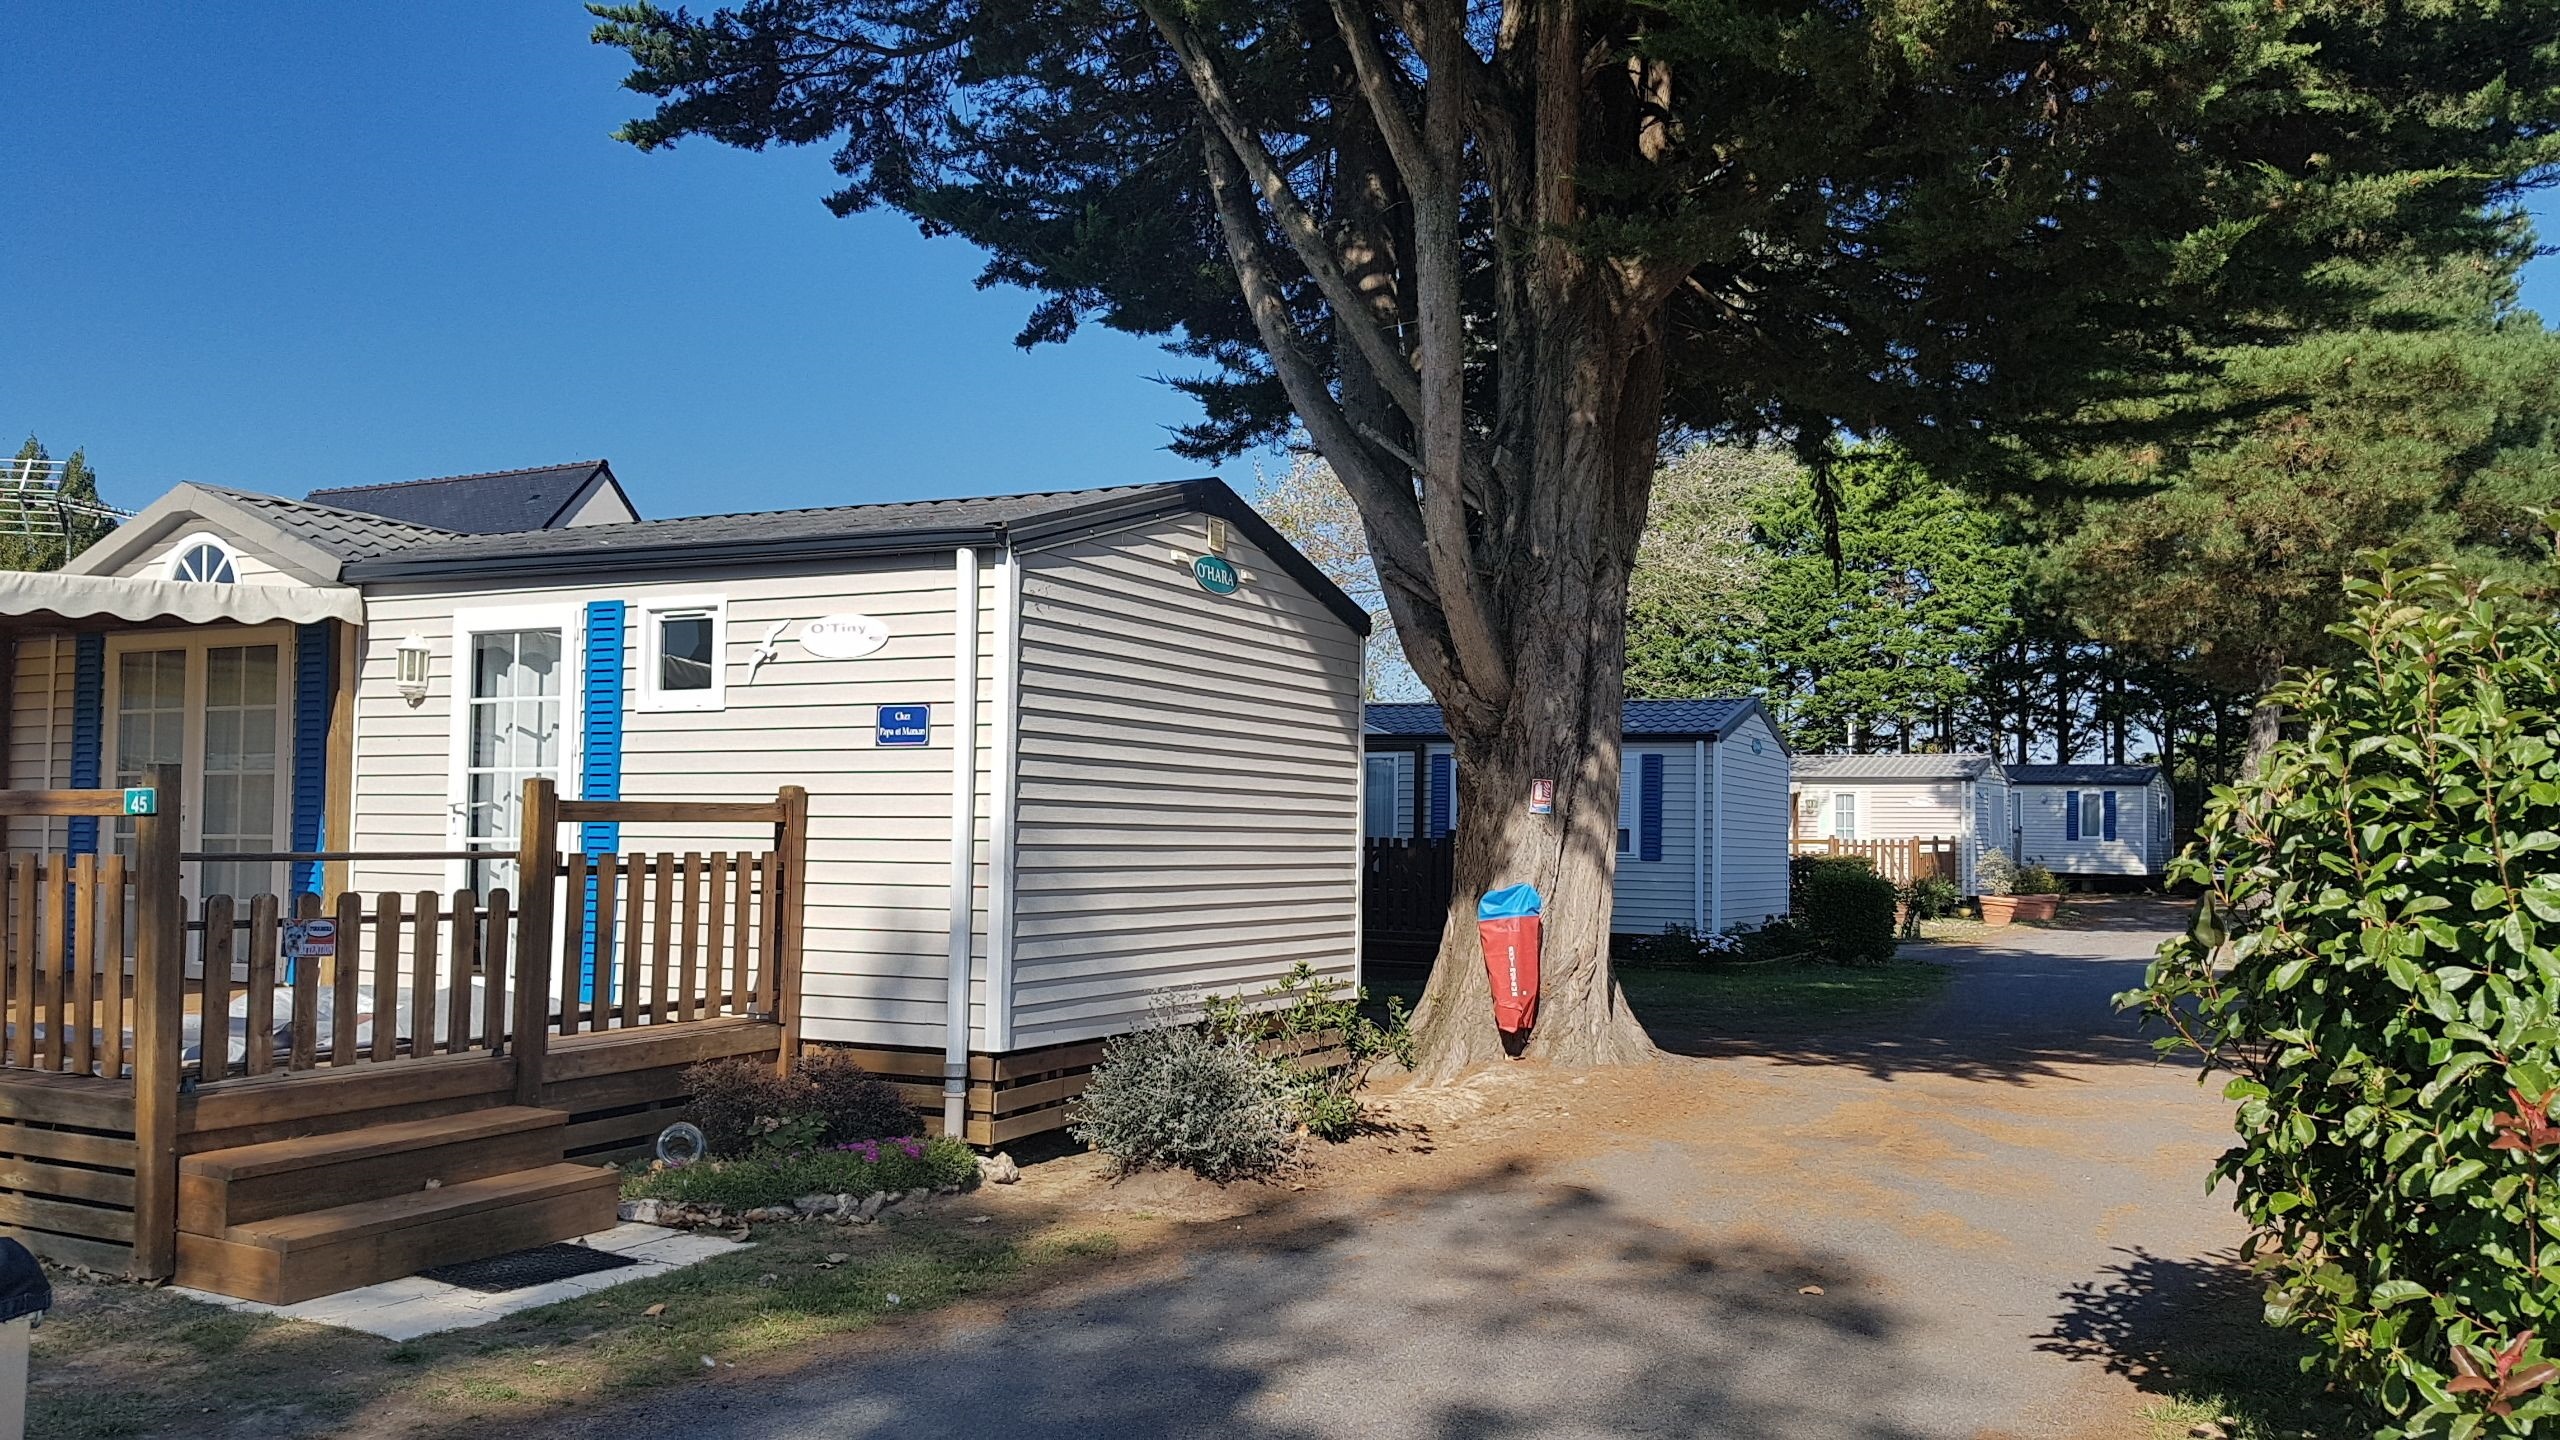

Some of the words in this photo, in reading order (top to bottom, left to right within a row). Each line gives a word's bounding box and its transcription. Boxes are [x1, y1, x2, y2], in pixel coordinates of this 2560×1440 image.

[1197, 562, 1234, 587] O'HARA
[811, 623, 866, 634] O'Tiny
[130, 795, 148, 813] 45
